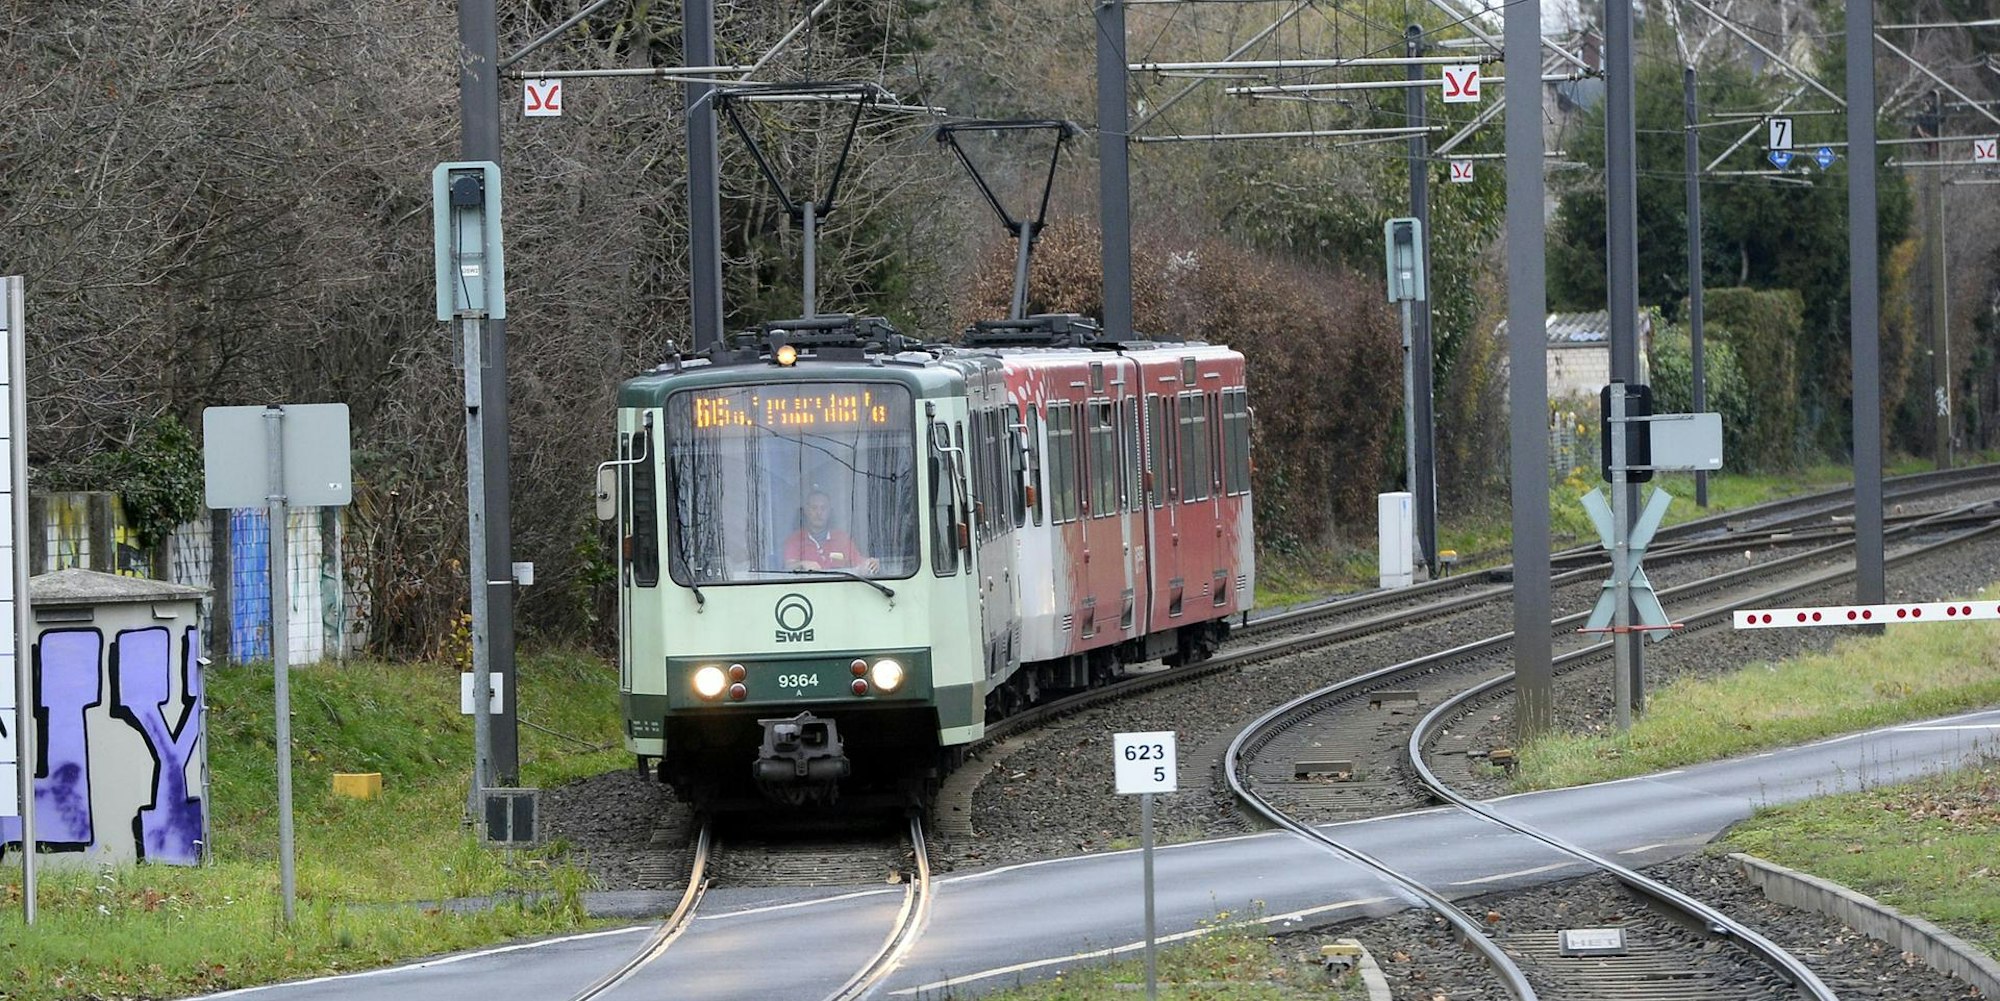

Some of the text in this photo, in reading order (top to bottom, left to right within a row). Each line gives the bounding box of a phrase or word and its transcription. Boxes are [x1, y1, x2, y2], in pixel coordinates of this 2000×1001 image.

[1775, 121, 1786, 147] 7
[775, 628, 814, 642] SWB
[778, 674, 819, 688] 9364
[796, 689, 803, 697] A
[1124, 744, 1164, 761] 623
[1154, 766, 1165, 782] 5
